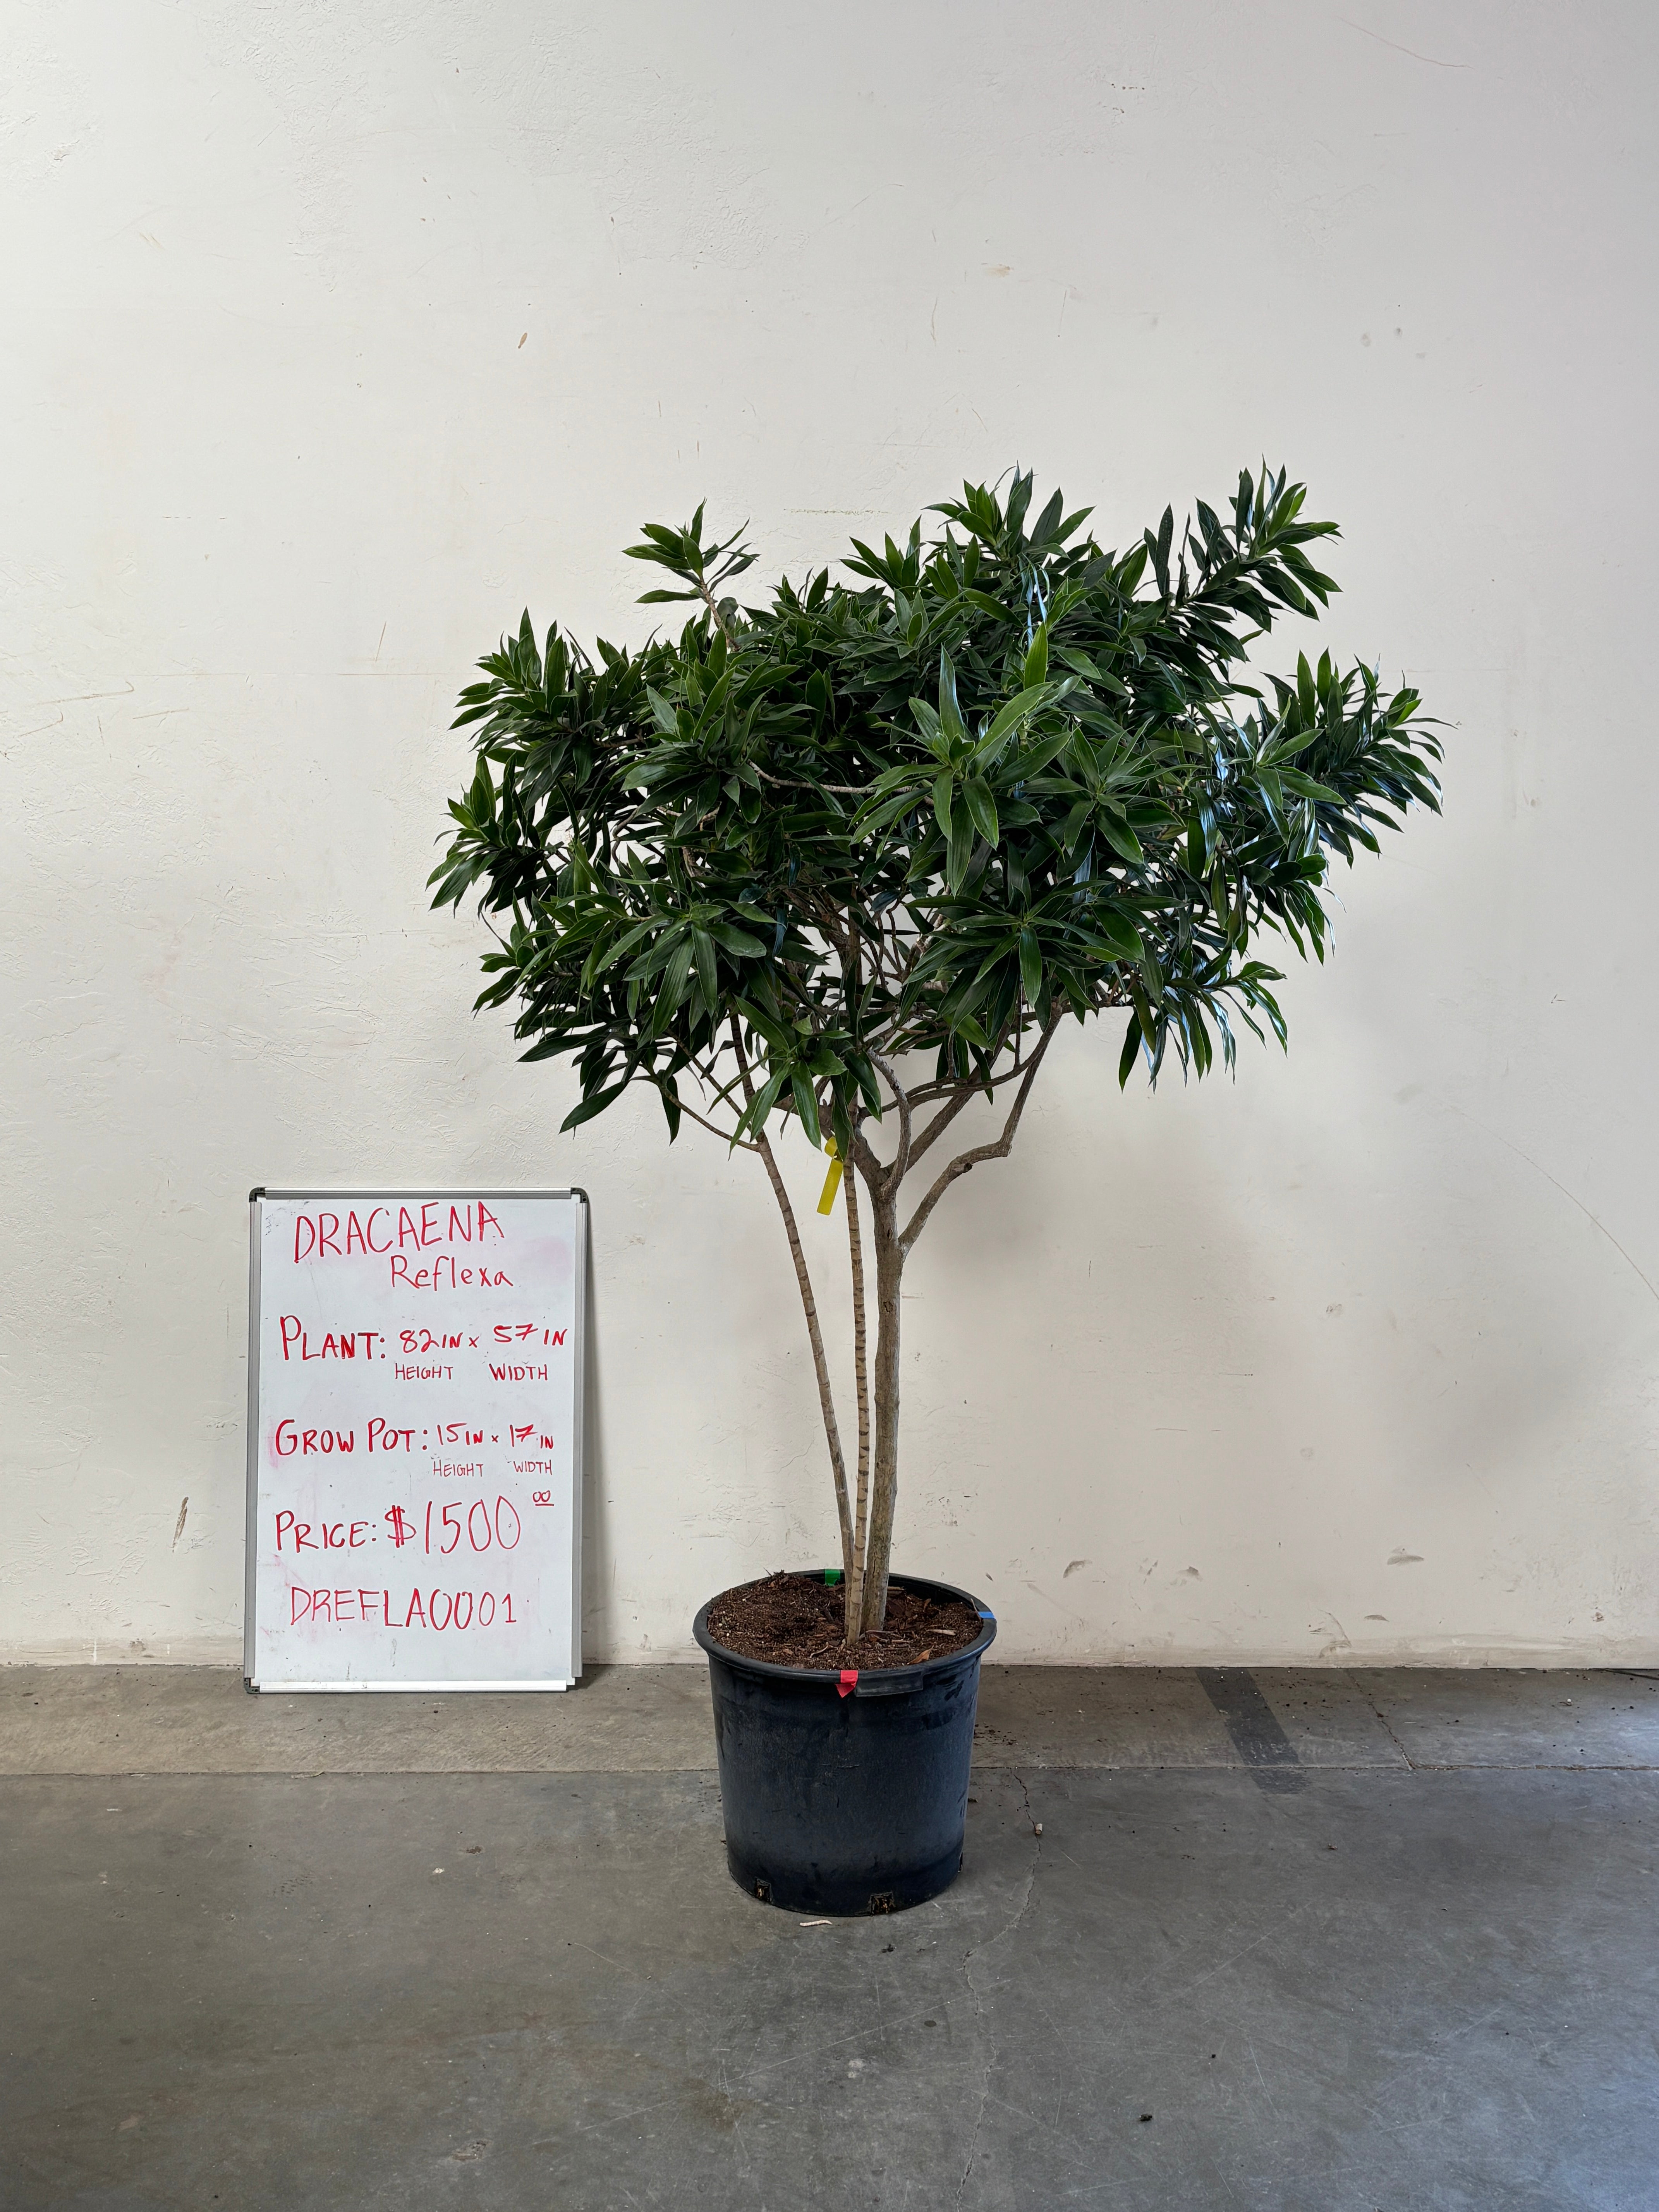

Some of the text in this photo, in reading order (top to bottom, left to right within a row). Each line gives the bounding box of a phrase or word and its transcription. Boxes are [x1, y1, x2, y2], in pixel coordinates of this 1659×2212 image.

[294, 1201, 505, 1263] DRACAENA
[390, 1255, 513, 1291] Reflexa
[280, 1315, 385, 1361] PLANT:
[395, 1364, 547, 1381] HEIGHT WIDTH
[276, 1419, 354, 1455] GROW
[367, 1418, 428, 1453] POT:
[433, 1460, 552, 1477] HEIGHT WIDTH
[275, 1510, 376, 1553] PRICE:
